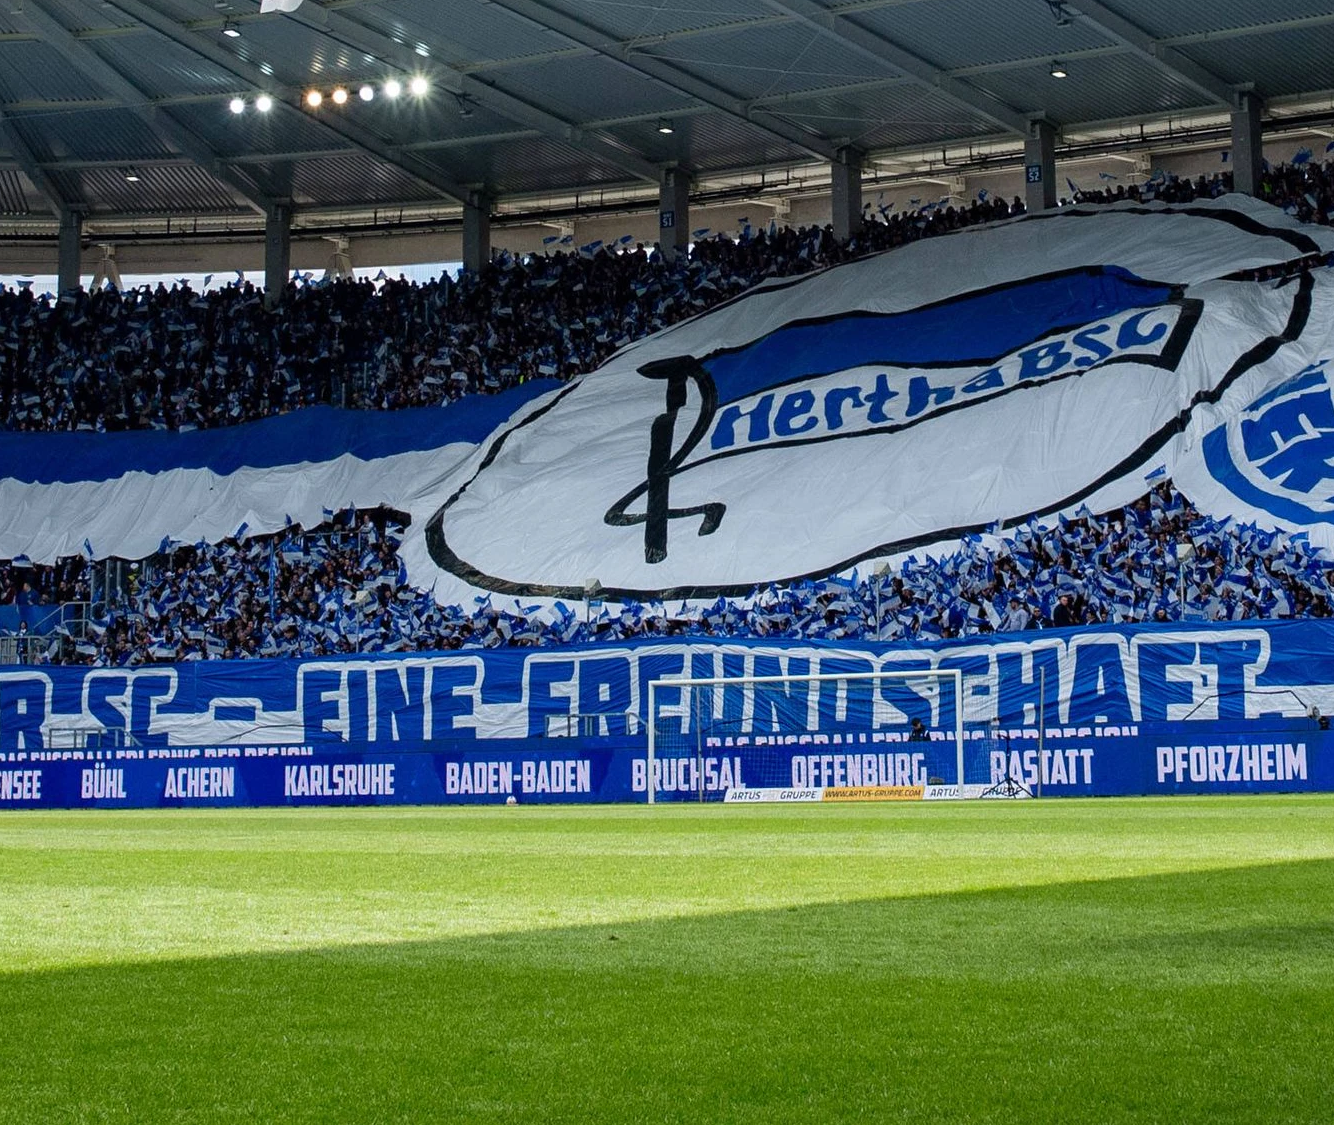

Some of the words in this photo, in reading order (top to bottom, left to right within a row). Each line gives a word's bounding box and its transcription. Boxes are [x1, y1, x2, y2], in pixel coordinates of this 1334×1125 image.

[710, 365, 1006, 451] Hertha
[1018, 309, 1170, 381] BSC
[83, 668, 178, 746] SC
[298, 655, 484, 743] EINE
[524, 628, 1270, 739] FREUNDSCHAFT
[81, 763, 127, 798] BÜHL
[164, 768, 234, 798] ACHERN
[284, 763, 395, 796] KARLSRUHE
[445, 759, 591, 794] BADEN-BADEN
[631, 756, 747, 792] BRUCHSAL
[791, 752, 928, 788] OFFENBURG
[990, 748, 1095, 786] RASTATT
[1156, 743, 1308, 782] PFORZHEIM
[731, 790, 761, 800] ARTUS
[780, 790, 818, 800] GRUPPE
[825, 789, 922, 799] WWW.ARTUS-GRUPPE.COM
